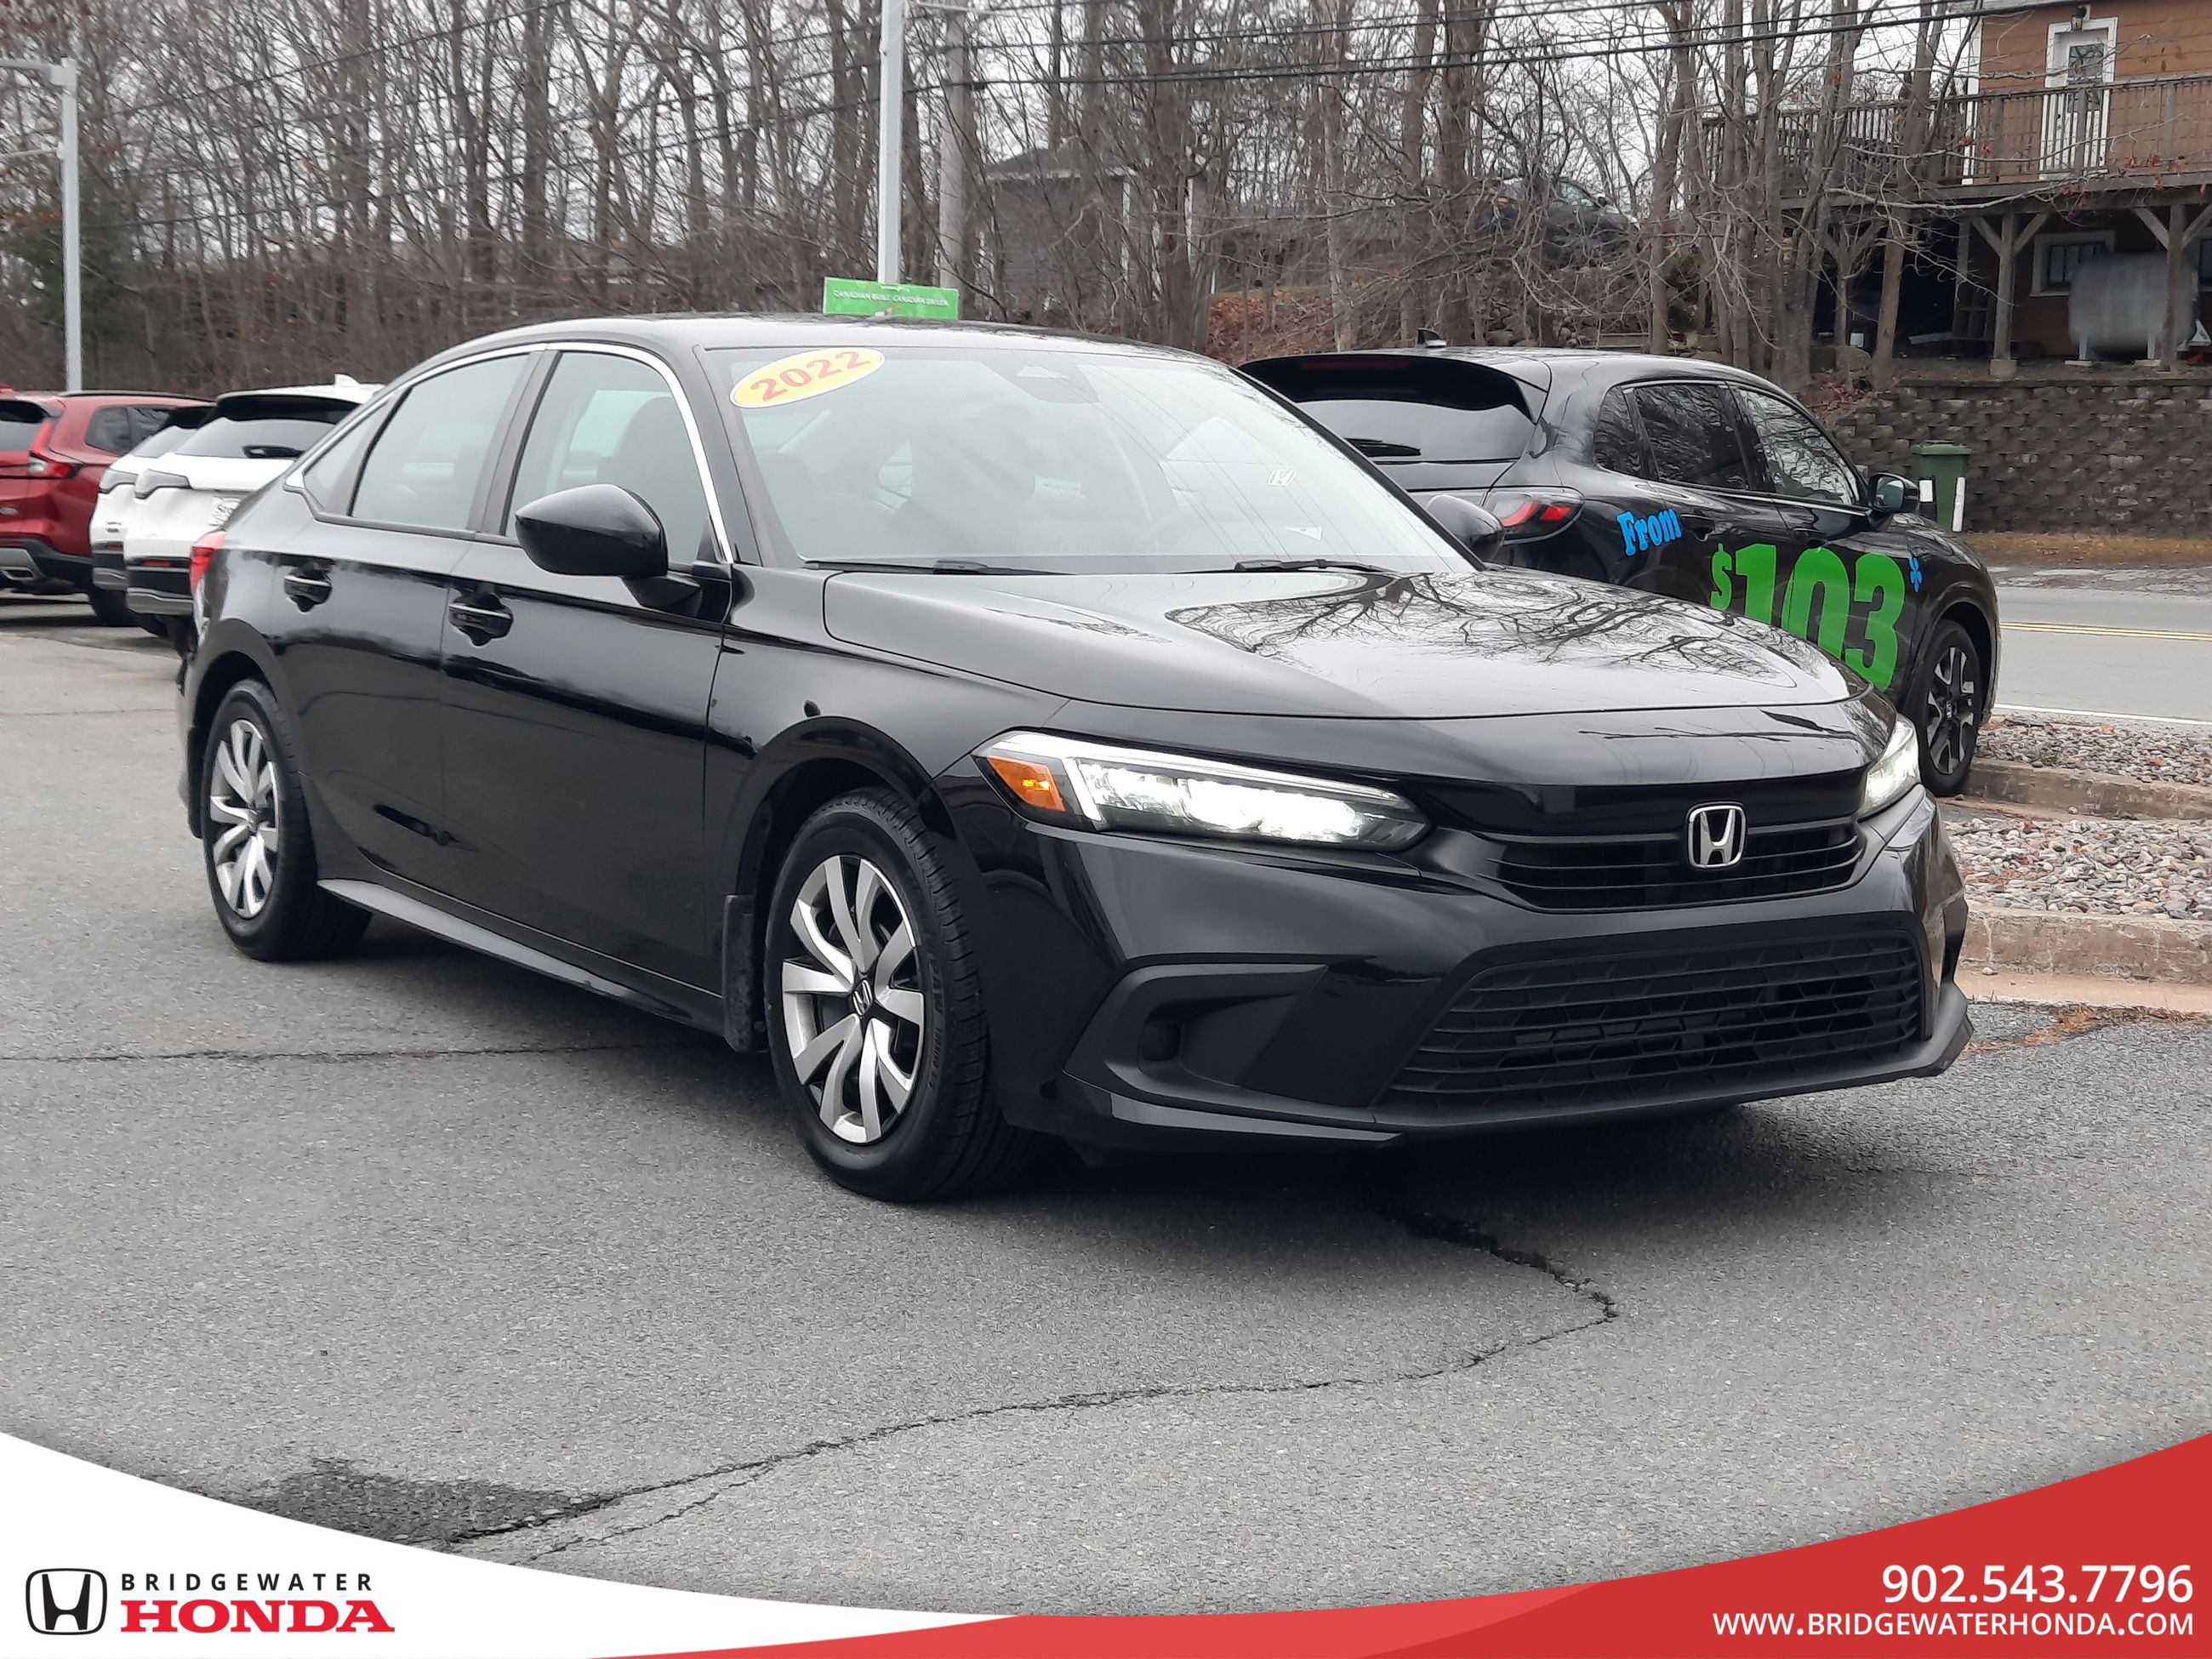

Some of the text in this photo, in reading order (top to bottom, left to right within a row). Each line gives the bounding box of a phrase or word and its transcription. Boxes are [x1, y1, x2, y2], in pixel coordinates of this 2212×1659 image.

[833, 289, 871, 300] CANADIAN
[892, 294, 926, 305] CANADIAN
[750, 351, 871, 402] 2022
[1616, 508, 1683, 557] From
